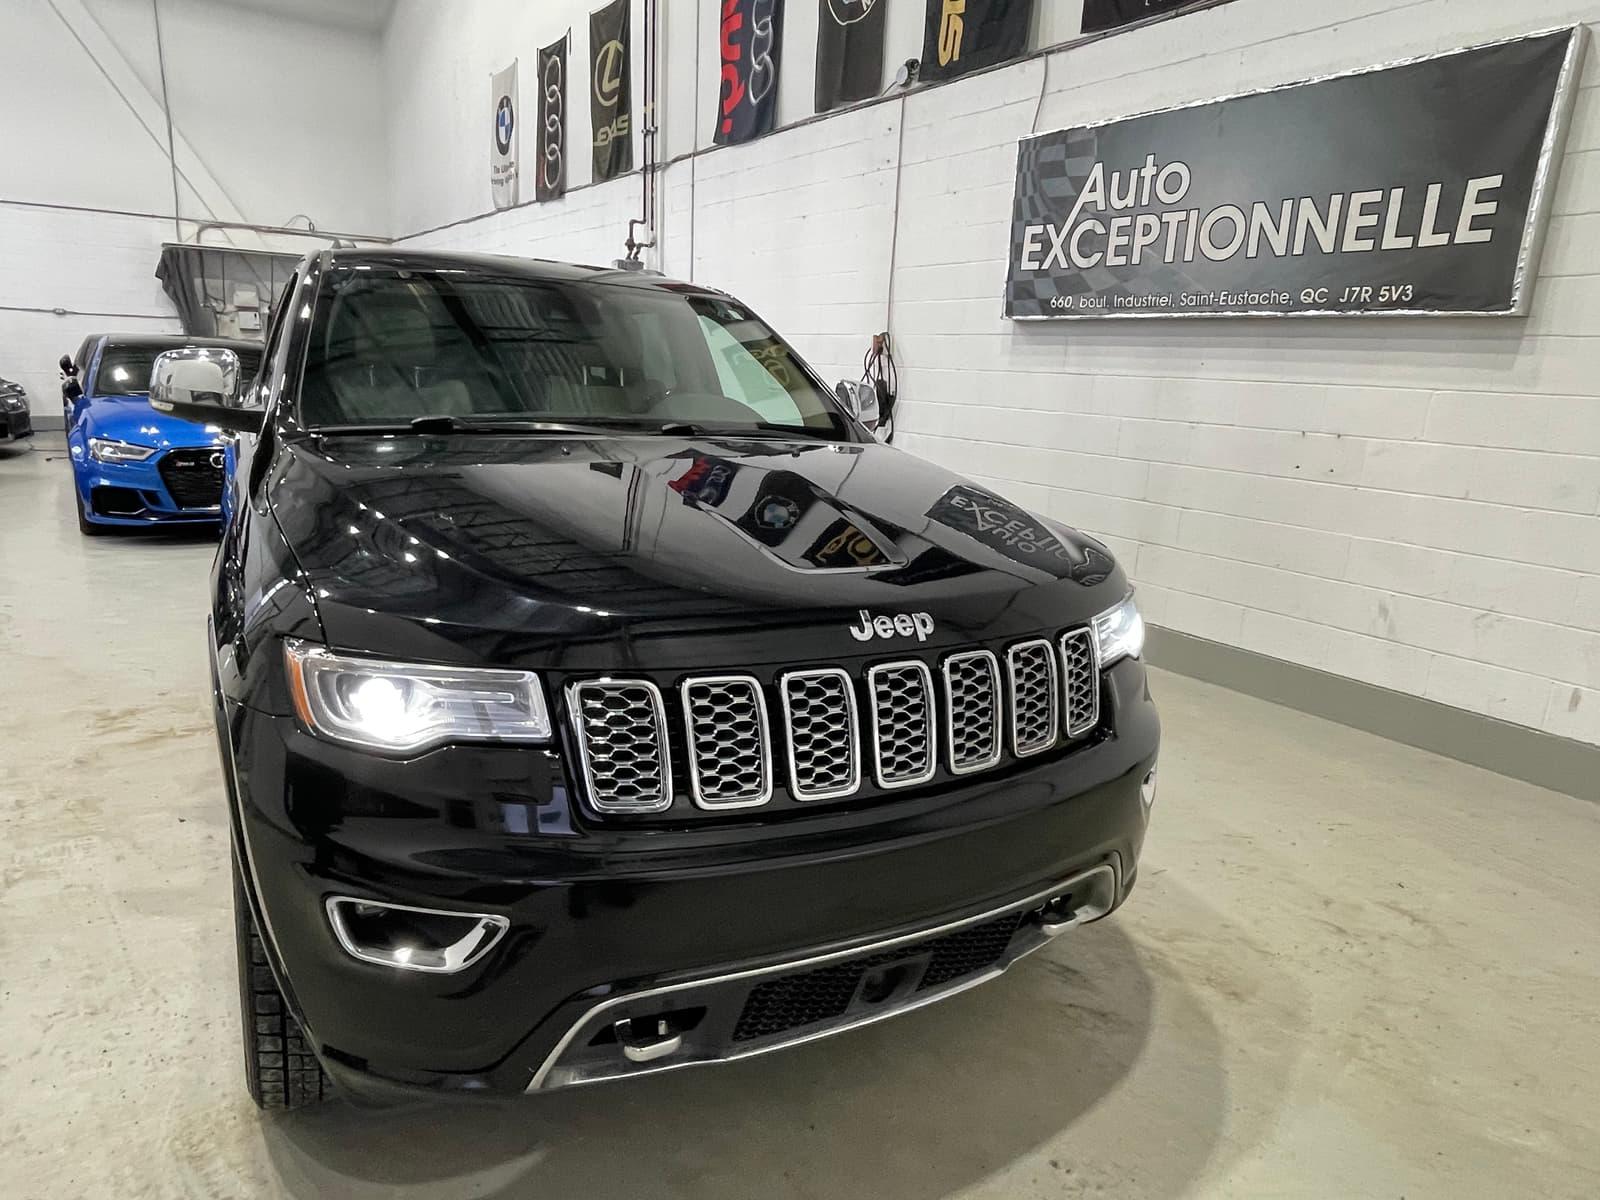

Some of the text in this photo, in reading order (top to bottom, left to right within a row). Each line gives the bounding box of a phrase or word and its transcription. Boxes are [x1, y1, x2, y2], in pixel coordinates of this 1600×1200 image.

[1070, 153, 1192, 212] Auto
[1020, 174, 1504, 272] EXCEPTIONNELLE
[1050, 284, 1414, 309] 660, boul. Industriel, Saint-Eustache, QC J7R 5V3
[849, 609, 935, 642] Jeep
